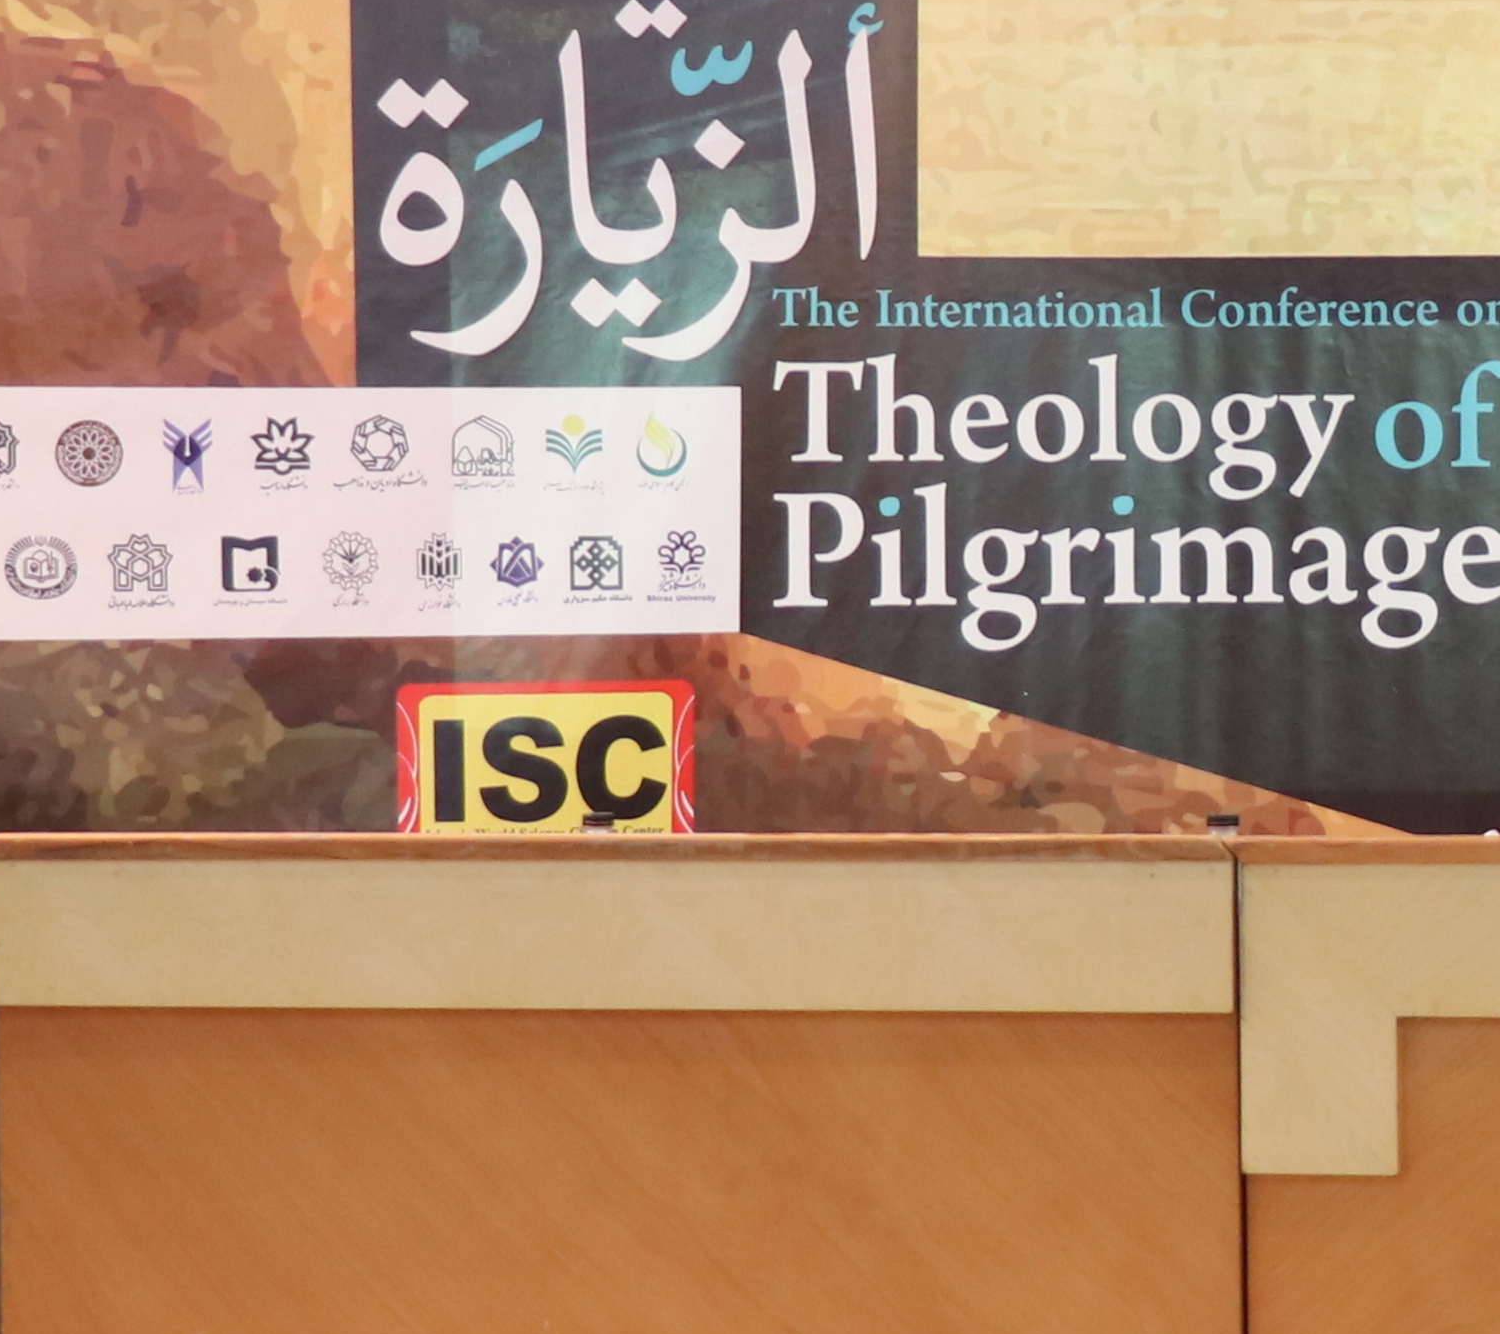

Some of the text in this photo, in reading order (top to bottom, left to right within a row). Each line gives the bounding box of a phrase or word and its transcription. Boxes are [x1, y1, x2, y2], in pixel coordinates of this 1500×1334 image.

[772, 286, 859, 328] The
[876, 287, 1165, 329] International
[1181, 287, 1440, 329] Conference
[772, 353, 1355, 502] Theology
[646, 594, 717, 604] Shiraz University
[433, 714, 668, 824] ISC
